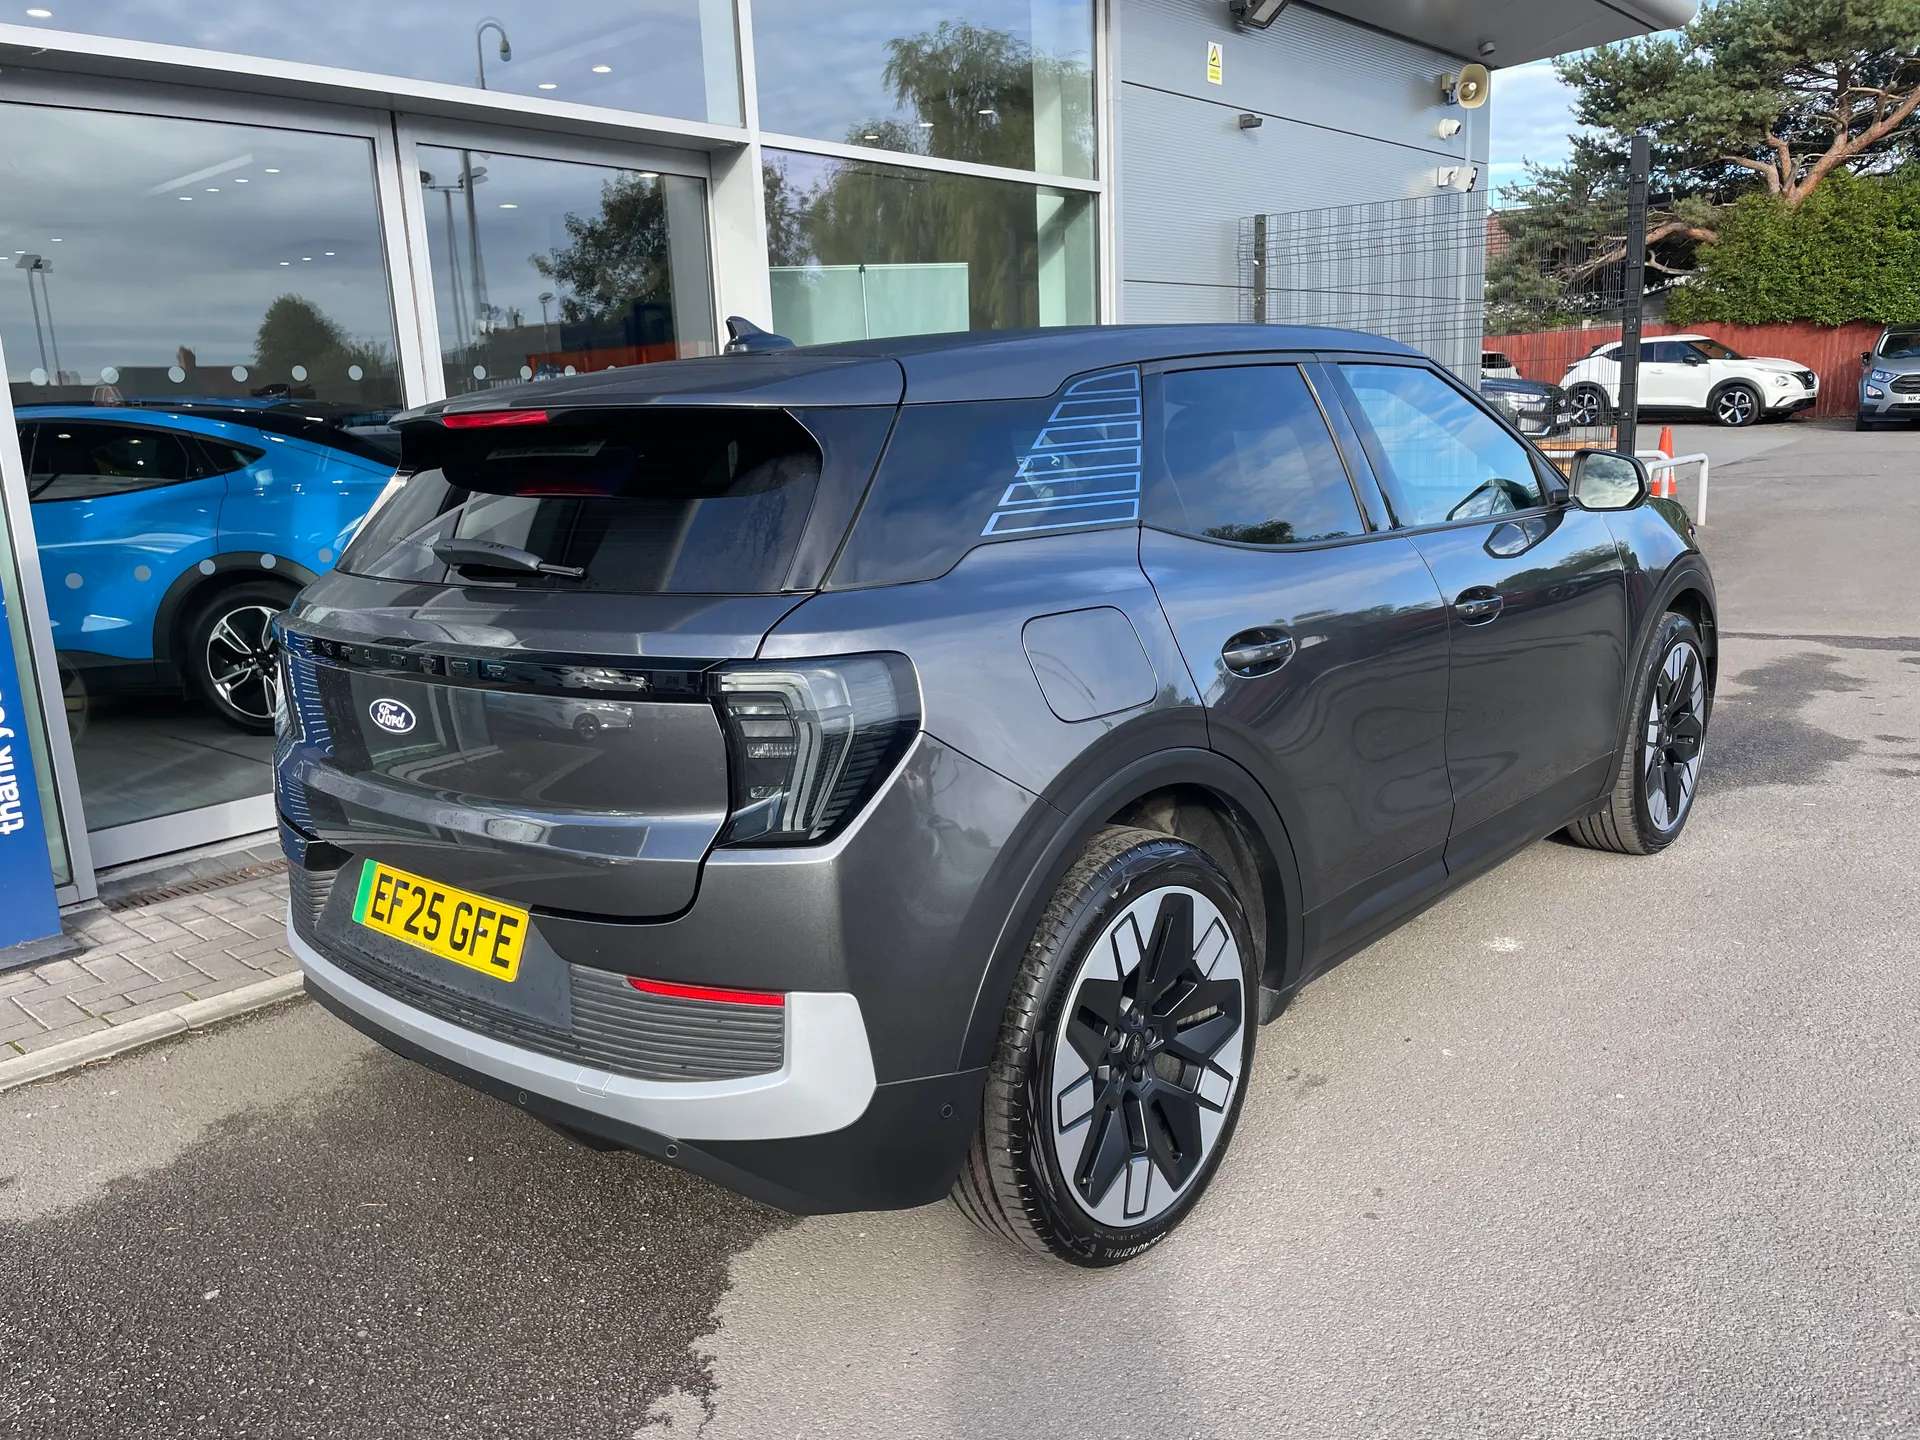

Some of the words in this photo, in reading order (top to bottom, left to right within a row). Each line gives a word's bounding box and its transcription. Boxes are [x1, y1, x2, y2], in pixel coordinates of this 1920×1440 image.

[376, 701, 406, 729] Ford
[370, 872, 446, 942] EF25
[449, 901, 519, 969] GFE
